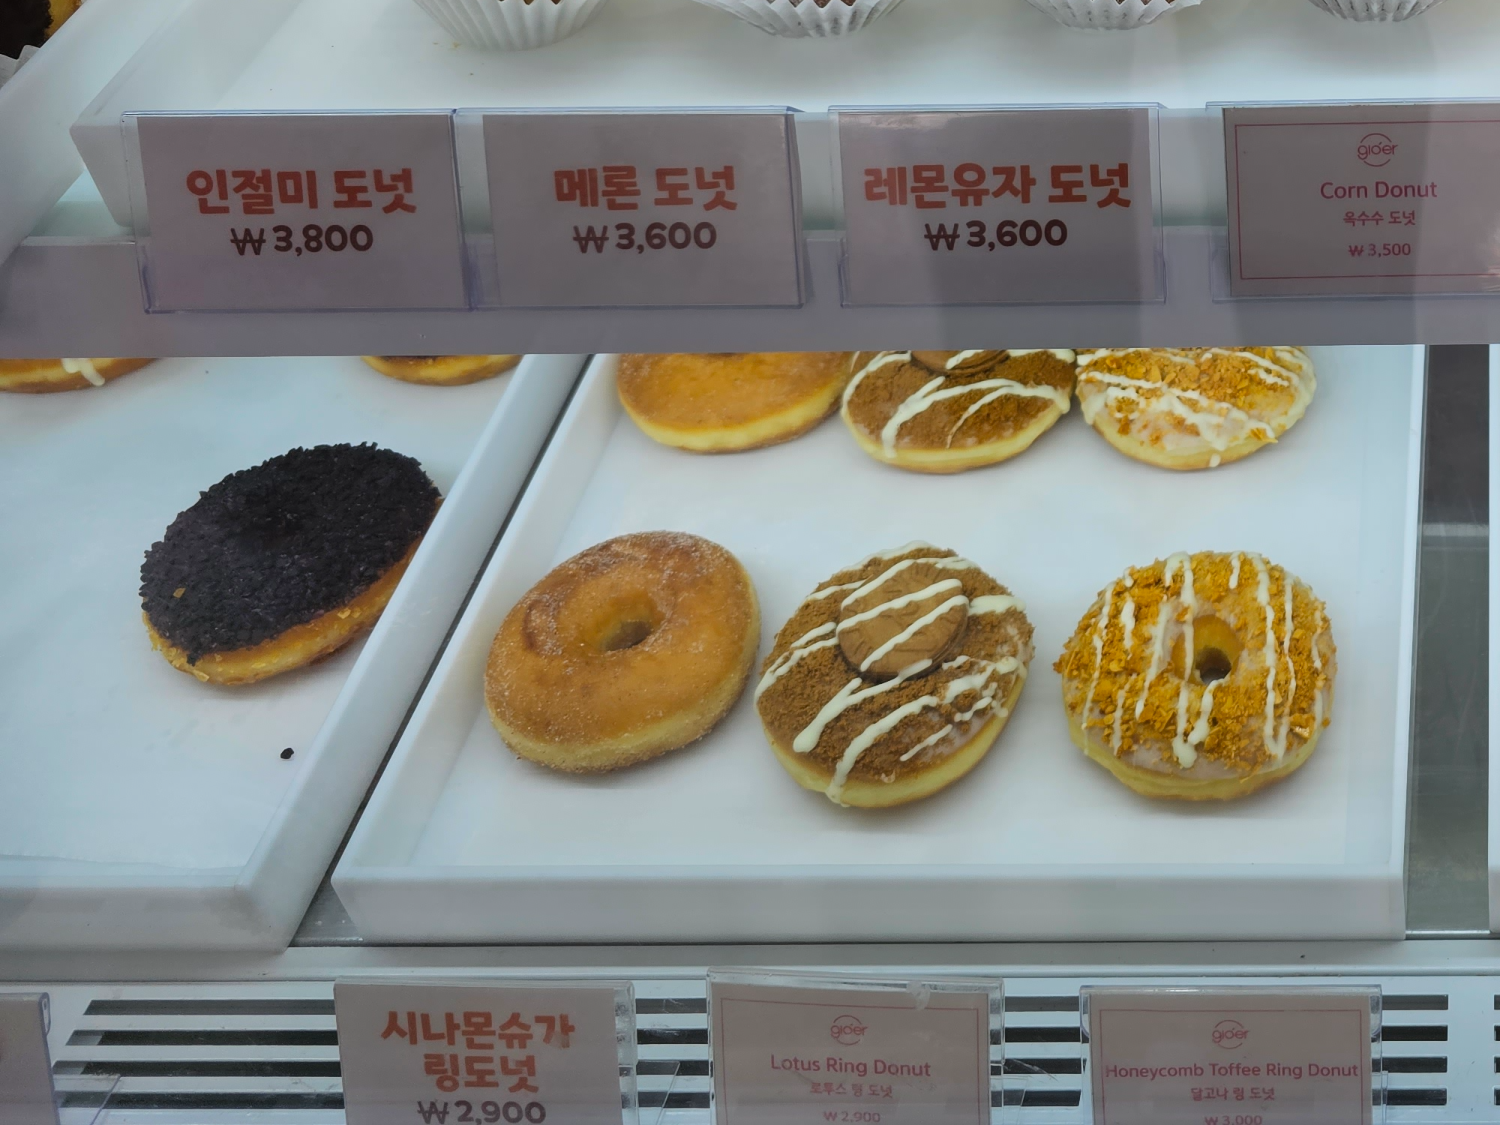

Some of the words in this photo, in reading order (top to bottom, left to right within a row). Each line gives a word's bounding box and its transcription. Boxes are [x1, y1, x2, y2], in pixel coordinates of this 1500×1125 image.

[186, 169, 317, 215] 인절미
[333, 168, 417, 215] 도넛
[554, 165, 641, 211] 메론
[653, 165, 738, 211] 도넛
[864, 163, 1037, 209] 레몬유자
[1047, 161, 1132, 209] 도넛
[1320, 181, 1368, 200] Corn
[1375, 180, 1438, 199] Donut
[1343, 211, 1384, 227] 옥수수
[1388, 210, 1416, 226] 도넛
[381, 1011, 575, 1049] 시나몬슈가
[424, 1053, 539, 1094] 링도넛
[771, 1055, 821, 1073] Lotus
[826, 1057, 868, 1078] Ring
[874, 1059, 932, 1078] Donut
[1105, 1062, 1204, 1081] Honeycomb
[1209, 1062, 1261, 1078] Toffee
[1266, 1062, 1303, 1080] Ring
[1308, 1063, 1358, 1078] Donut
[868, 1084, 893, 1099] 도넛
[1190, 1087, 1228, 1102] 달고나
[1232, 1087, 1245, 1101] 링
[1249, 1087, 1276, 1101] 도넛
